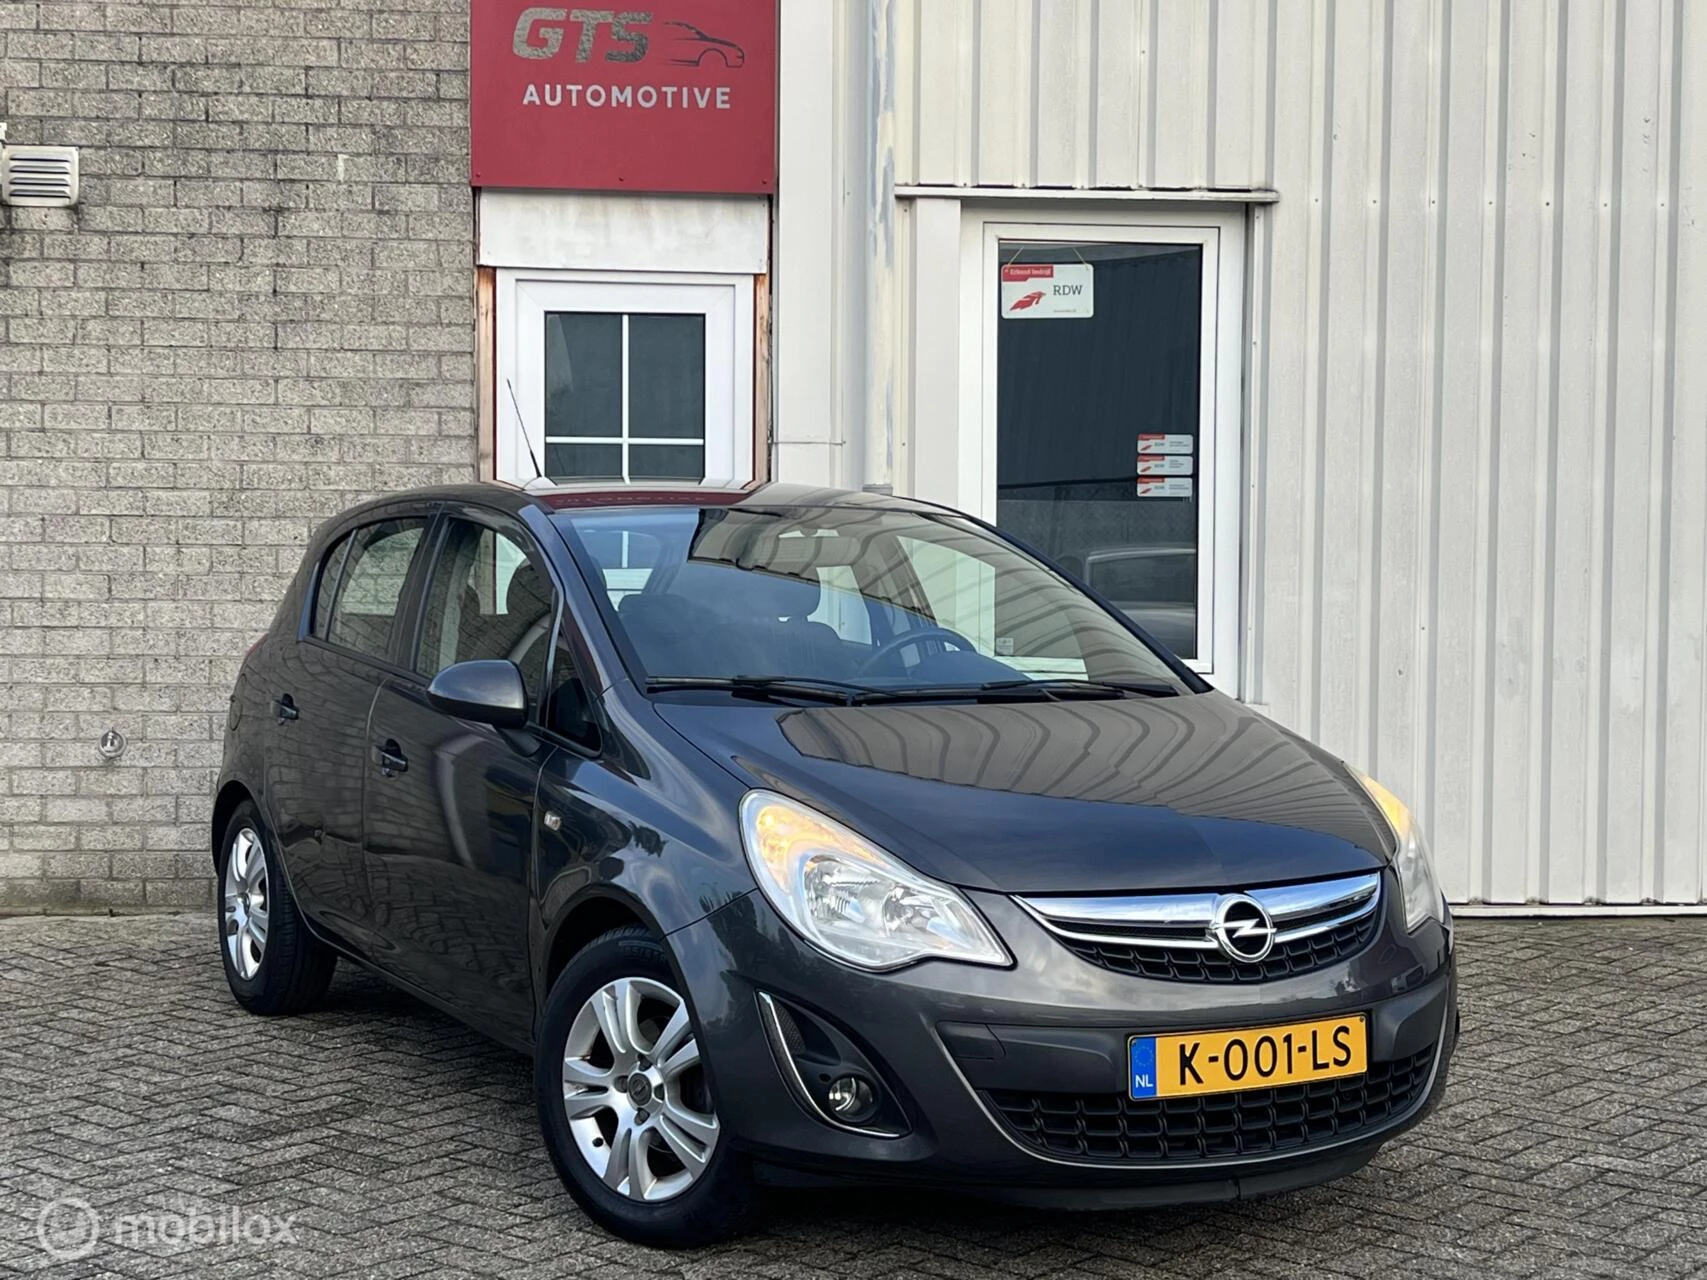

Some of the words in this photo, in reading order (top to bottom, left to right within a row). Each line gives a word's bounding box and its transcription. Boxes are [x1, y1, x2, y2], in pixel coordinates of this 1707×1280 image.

[512, 8, 652, 63] GTS
[522, 84, 731, 108] AUTOMOTIVE
[1053, 284, 1083, 296] RDW
[1179, 1025, 1352, 1086] K-001-LS
[1135, 1074, 1153, 1088] NL
